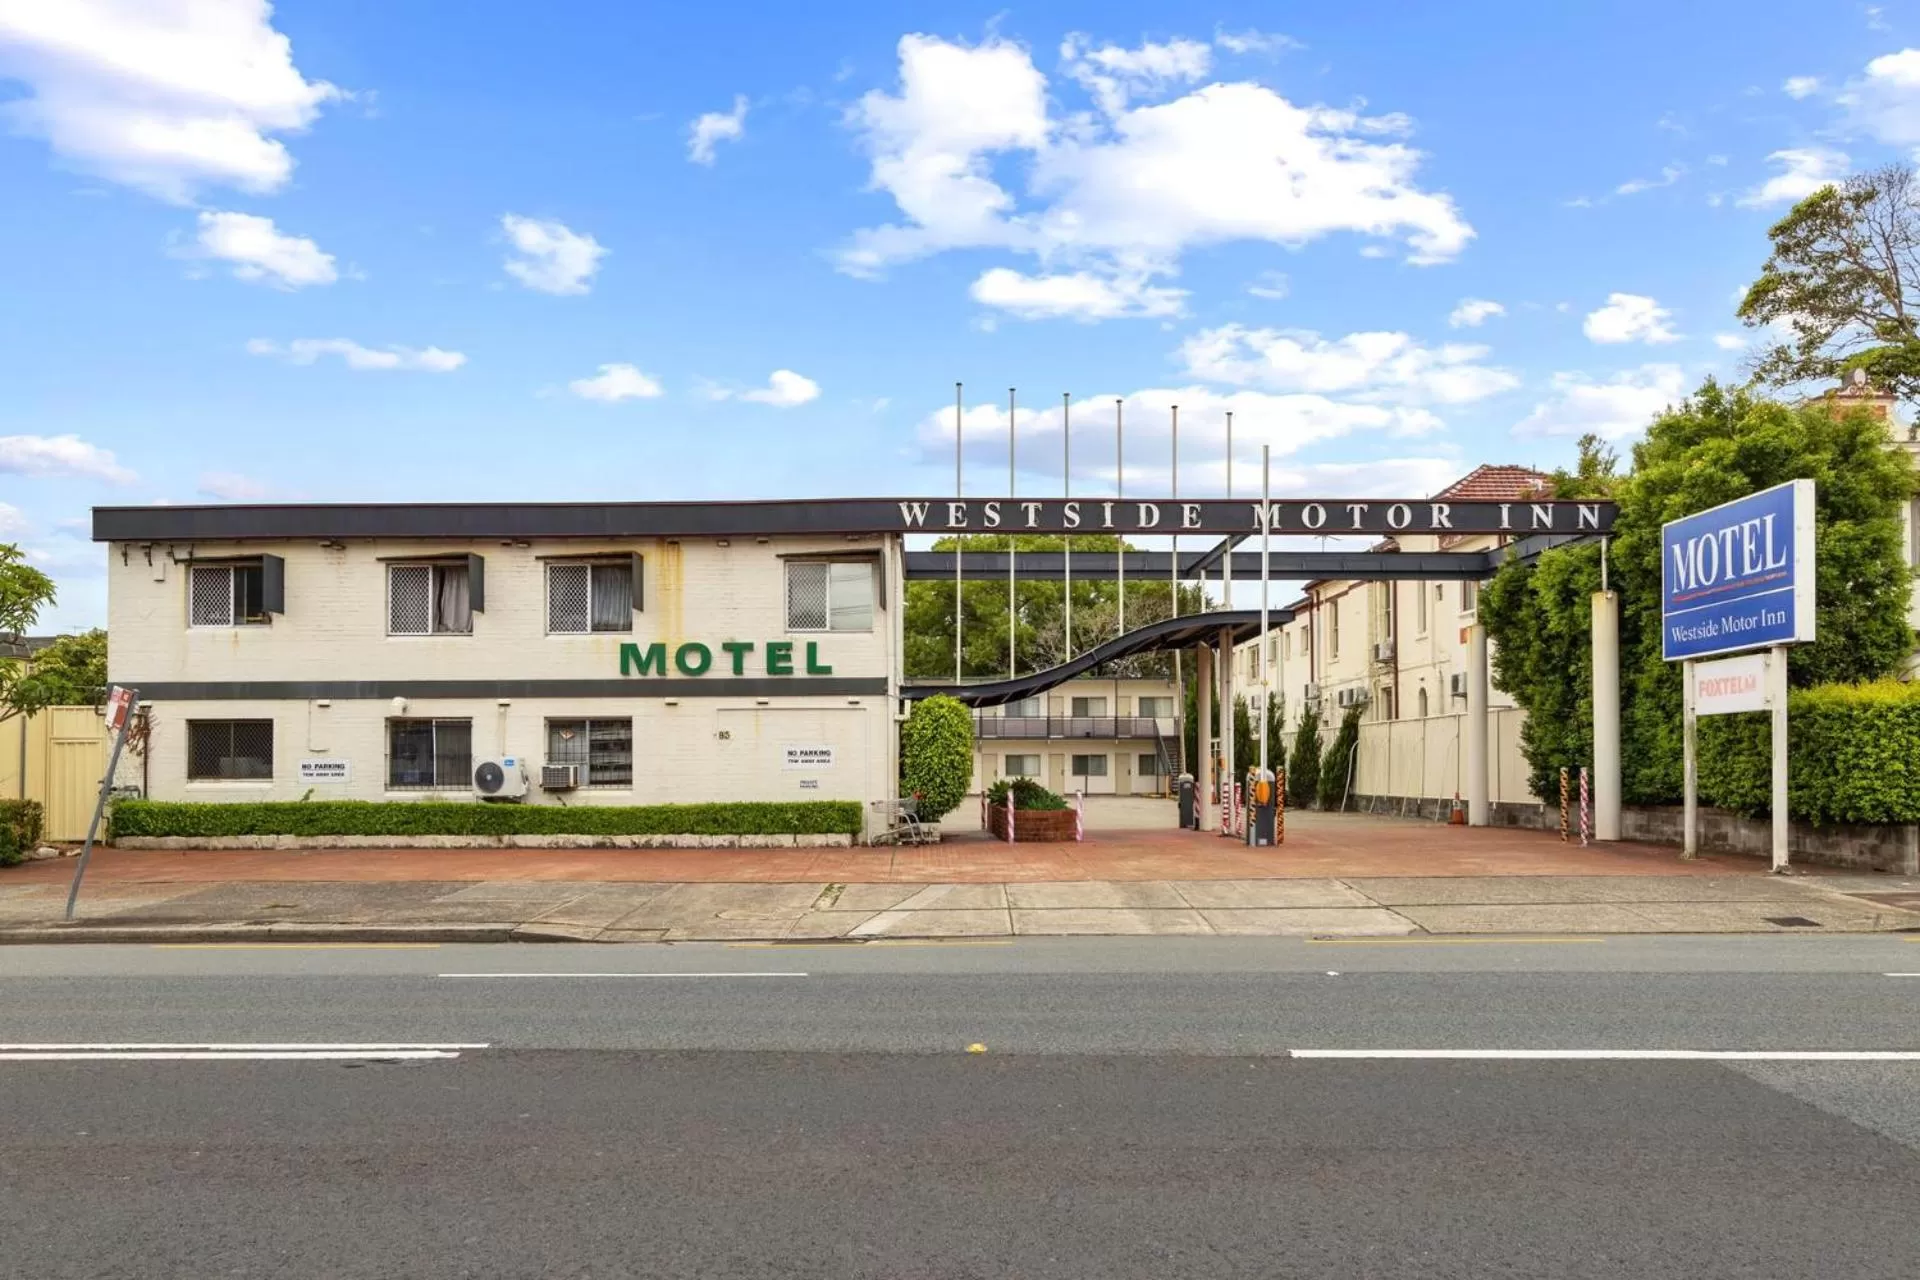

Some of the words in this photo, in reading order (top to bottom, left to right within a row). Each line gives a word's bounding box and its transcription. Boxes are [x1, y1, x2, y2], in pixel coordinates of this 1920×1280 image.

[899, 501, 1203, 528] WESTSIDE
[1252, 503, 1454, 530] MOTOR
[1498, 503, 1601, 530] INN
[1671, 513, 1787, 594] MOTEL
[1671, 620, 1719, 643] Westside
[1721, 614, 1758, 634] Motor
[1761, 609, 1786, 627] Inn
[619, 641, 833, 677] MOTEL
